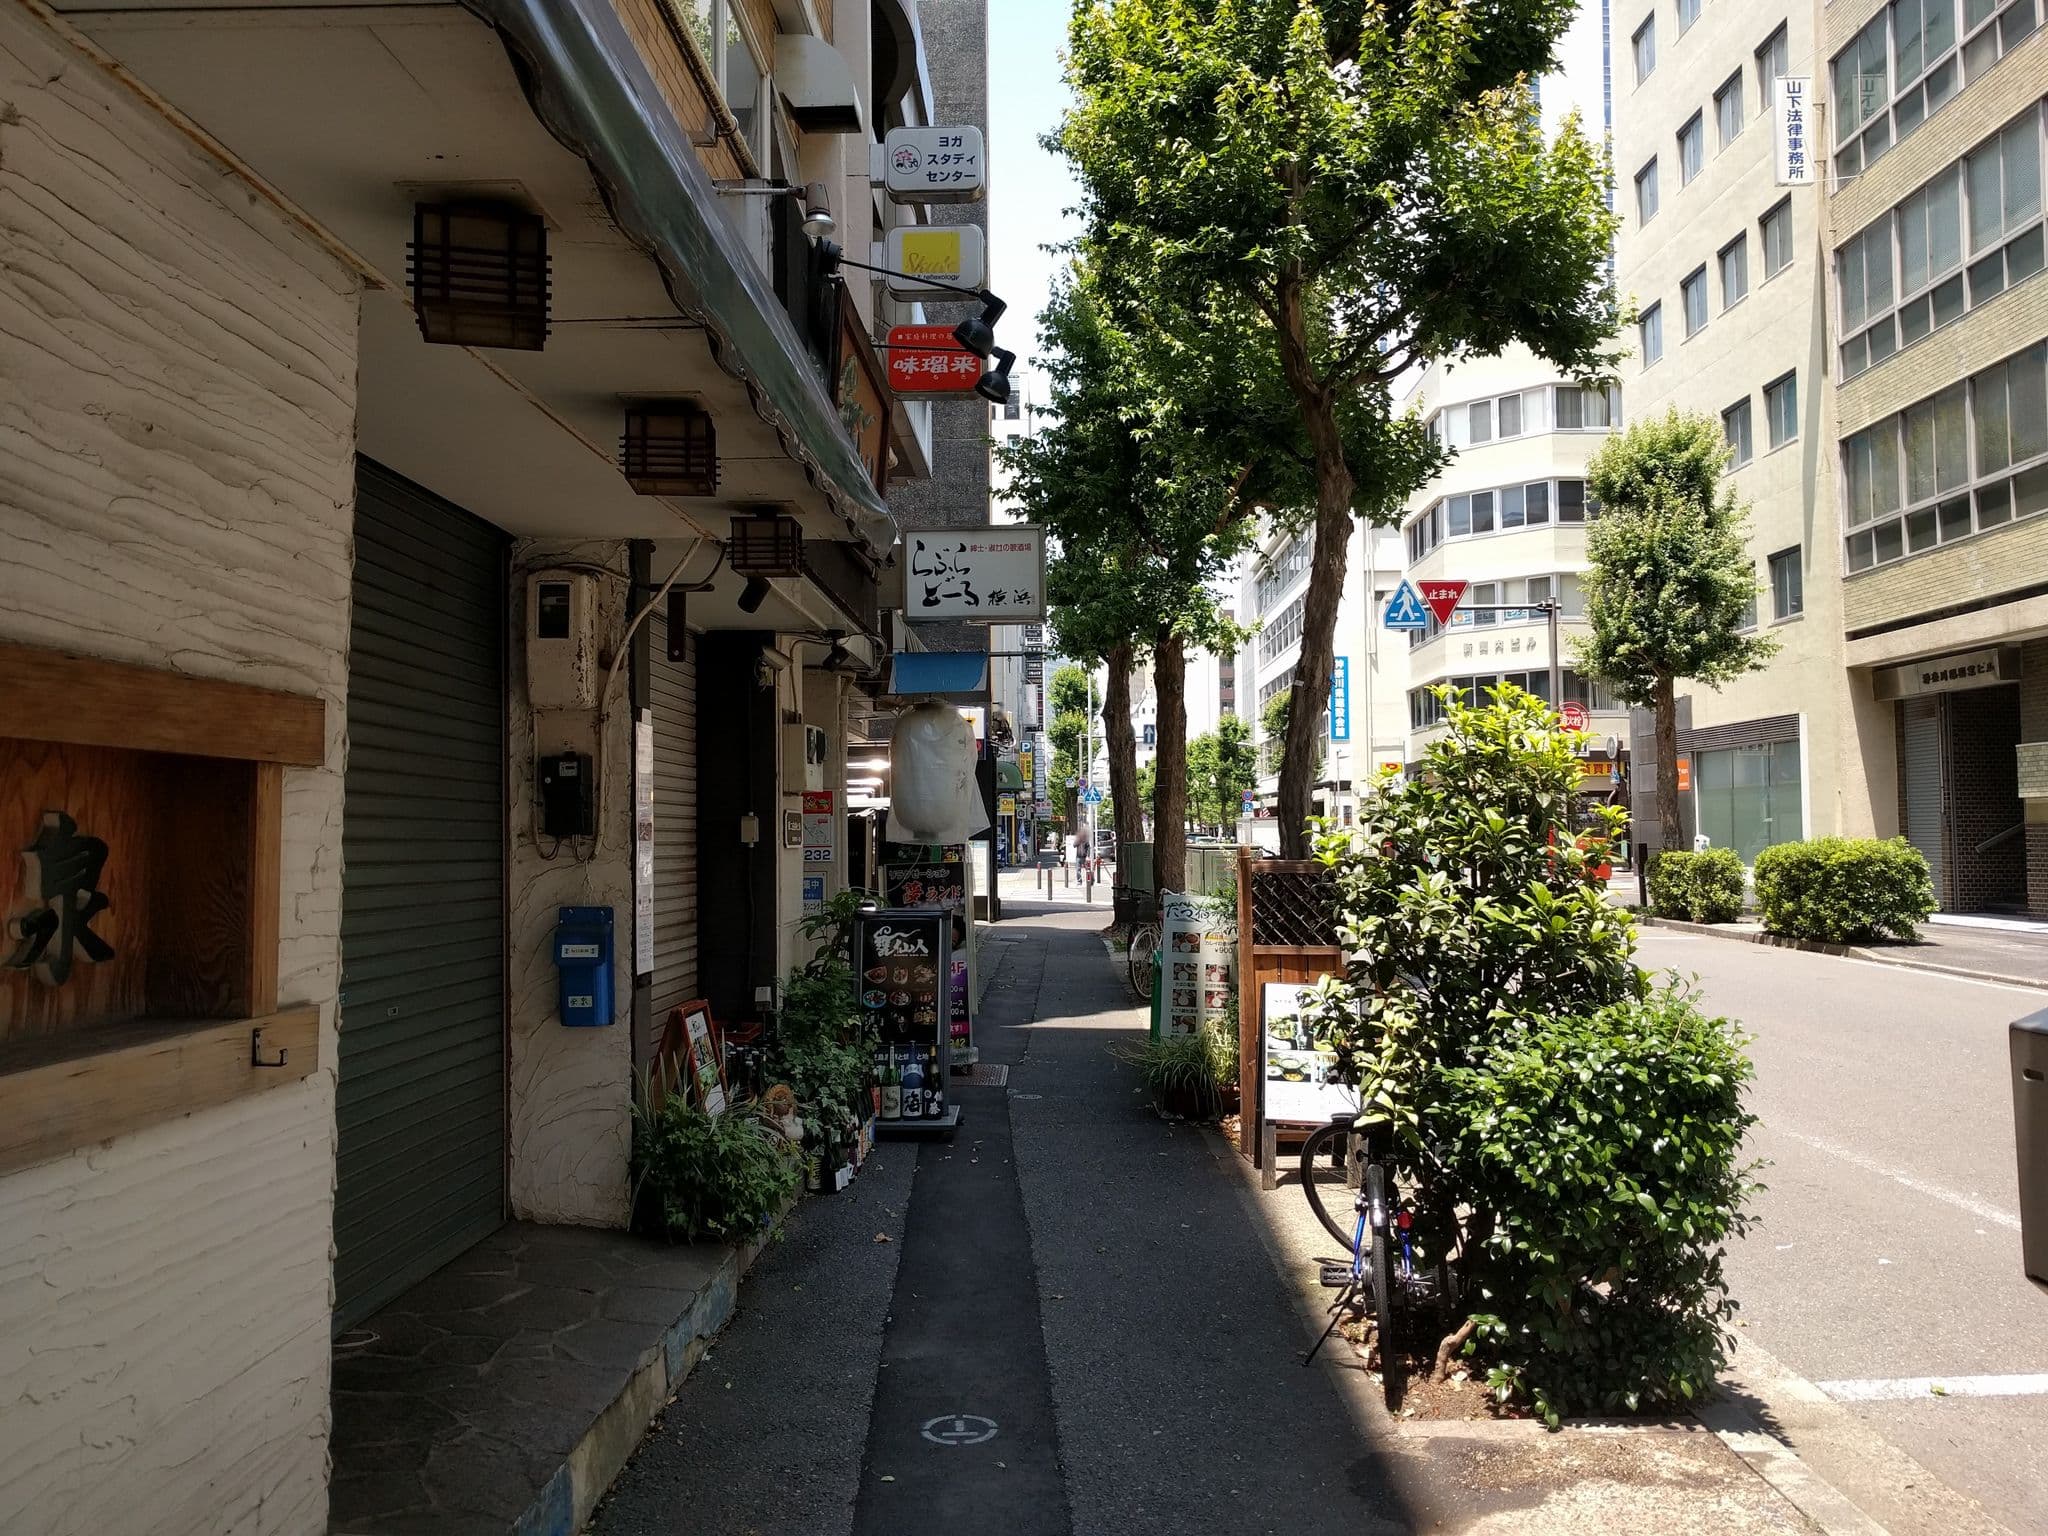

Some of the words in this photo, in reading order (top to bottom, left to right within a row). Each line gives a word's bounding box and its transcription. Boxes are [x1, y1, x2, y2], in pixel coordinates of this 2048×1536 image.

[1786, 80, 1804, 179] 山下法律事務所
[938, 136, 963, 148] ヨガ
[927, 153, 976, 166] スタディ
[926, 170, 976, 183] センター
[893, 355, 977, 374] 味瑠来
[987, 588, 1032, 606] 横浜
[1428, 589, 1458, 600] 止まれ
[804, 849, 831, 861] 232
